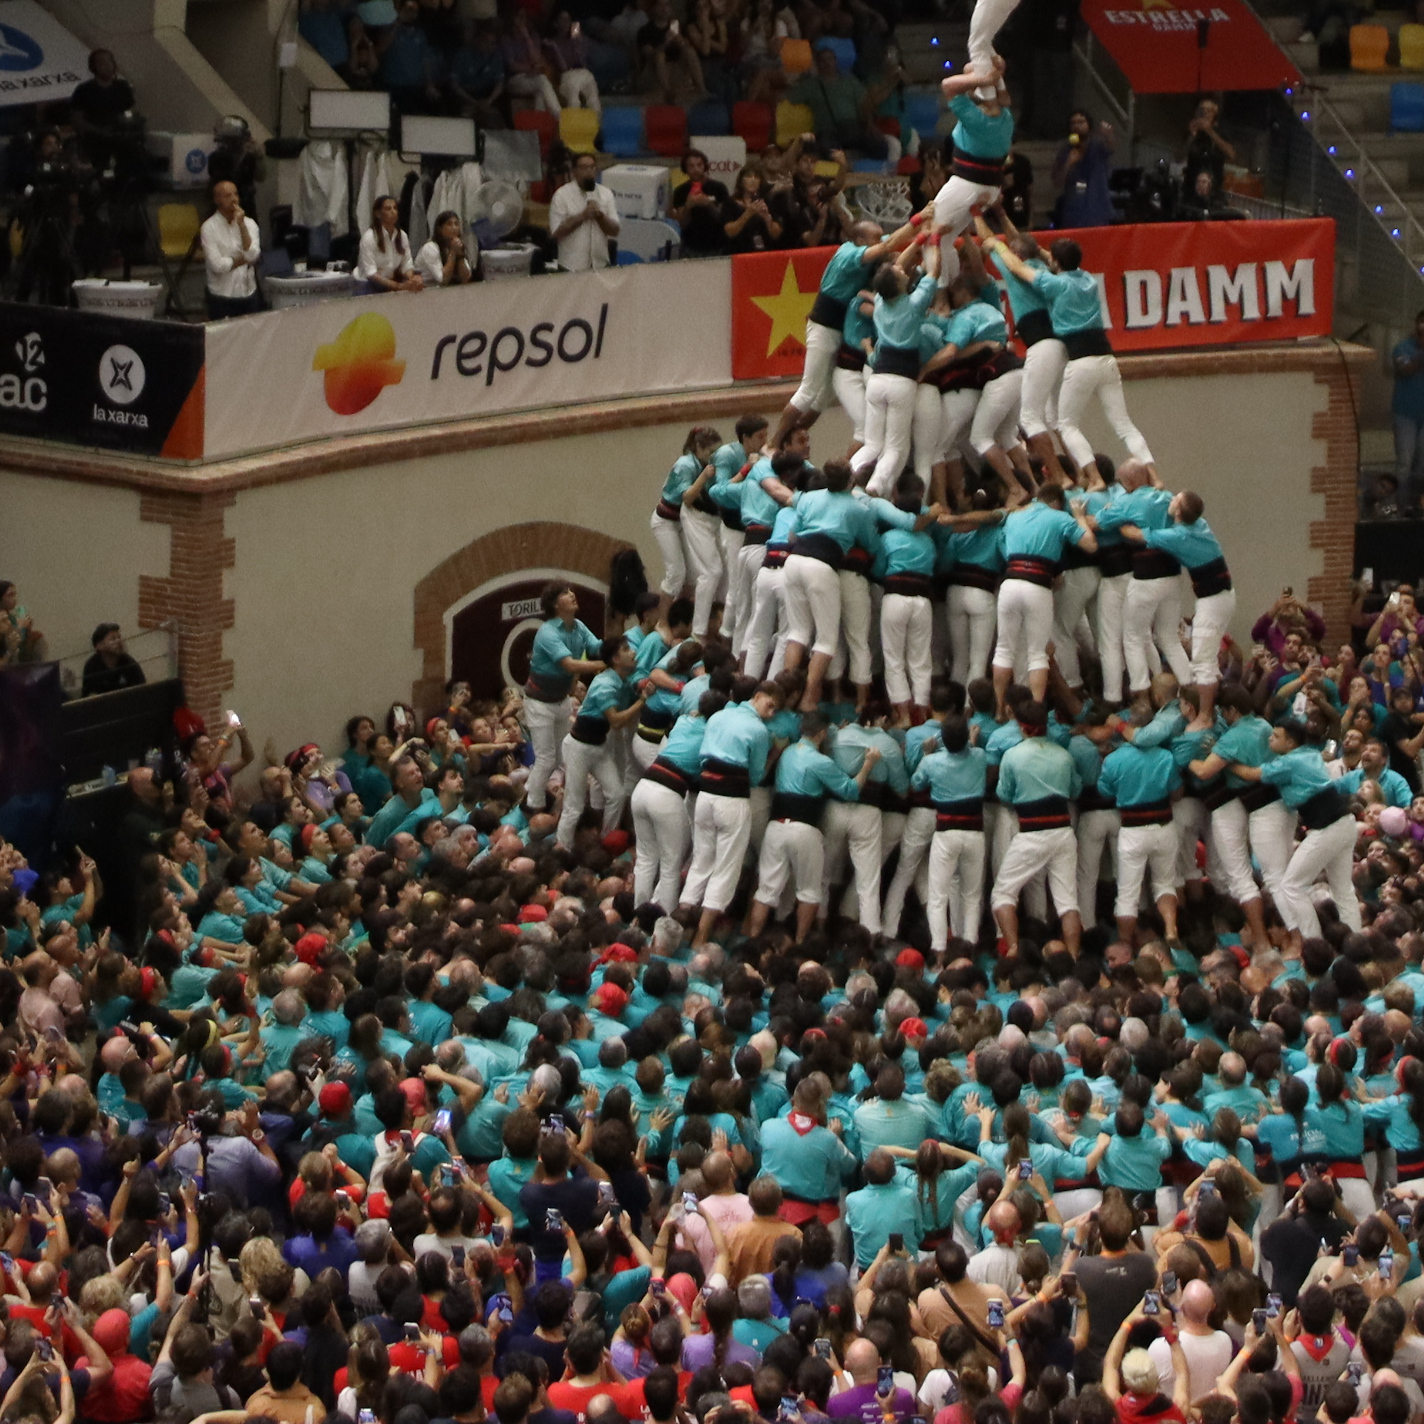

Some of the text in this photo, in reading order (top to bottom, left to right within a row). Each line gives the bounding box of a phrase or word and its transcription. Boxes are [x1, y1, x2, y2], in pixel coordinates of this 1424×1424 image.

[1103, 8, 1231, 25] ESTRELLA
[18, 70, 82, 89] xarxa
[1124, 257, 1317, 331] DAMM
[430, 302, 610, 387] repsol
[92, 403, 149, 429] la xarxa
[509, 601, 543, 617] TORIL
